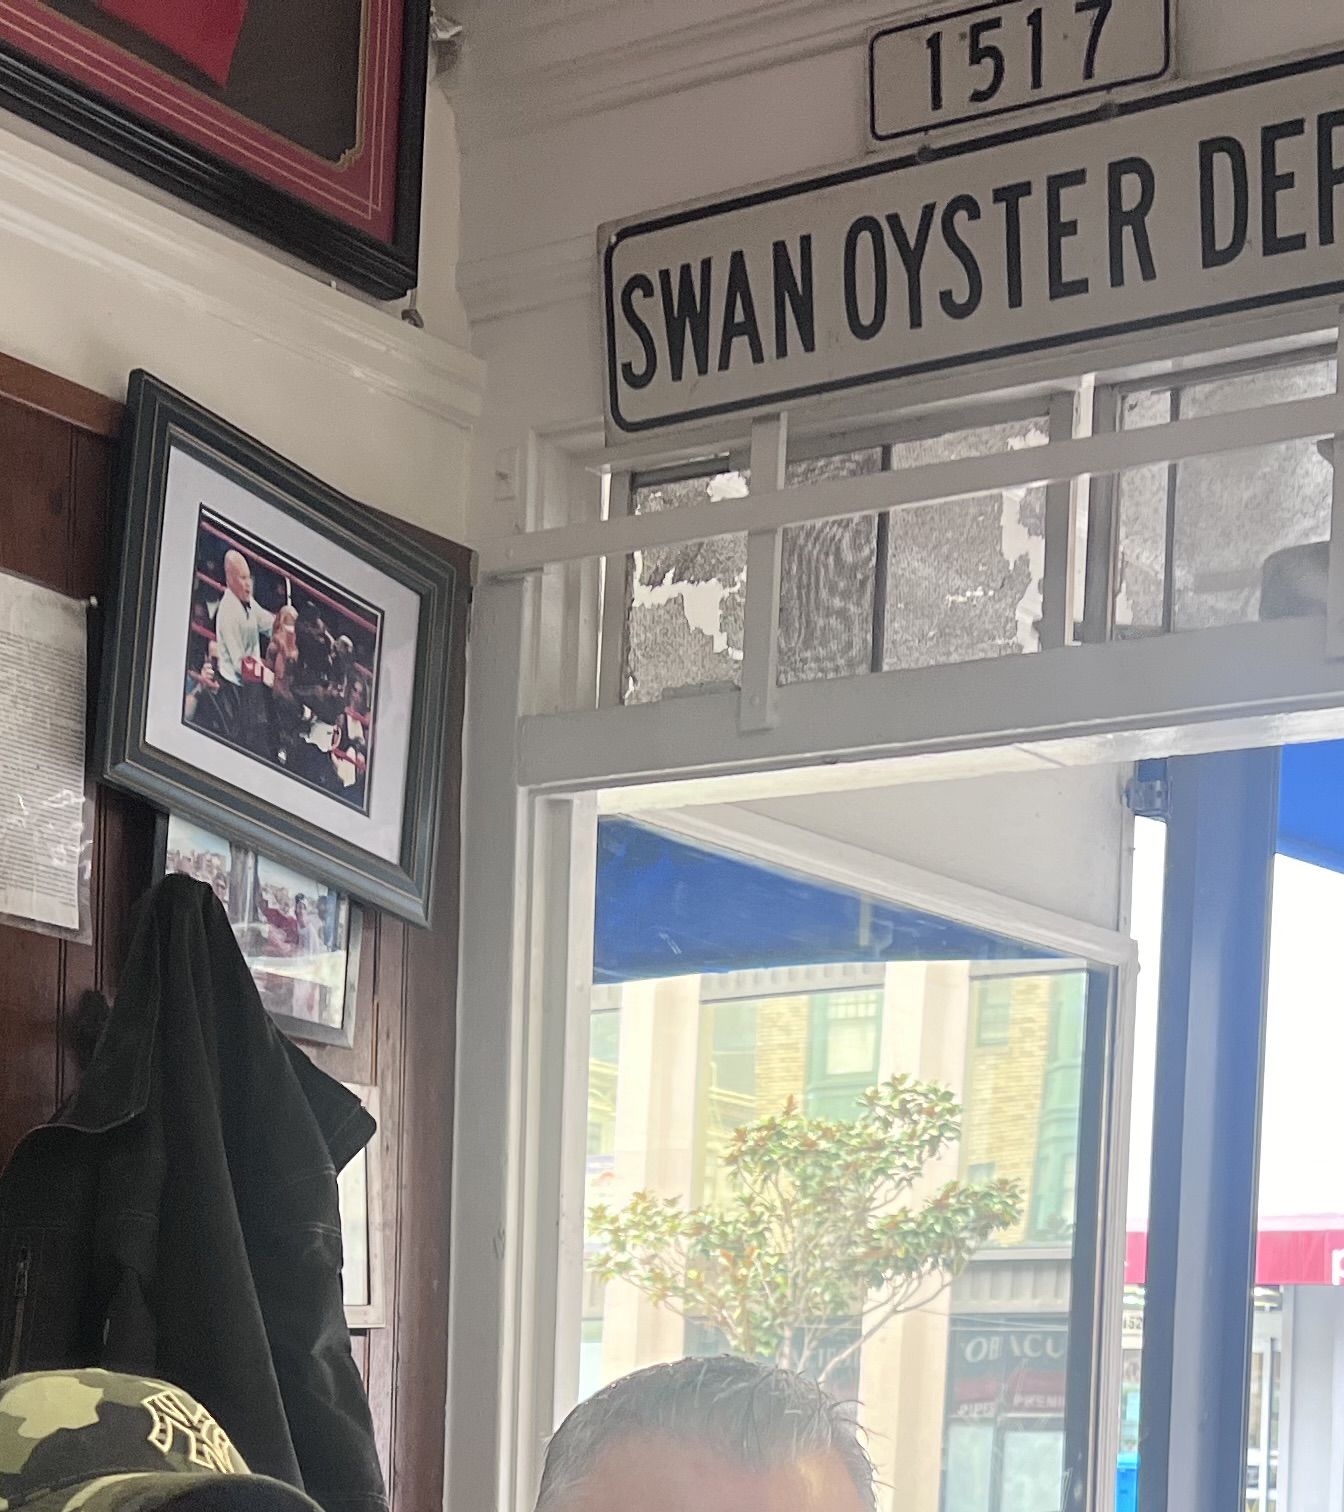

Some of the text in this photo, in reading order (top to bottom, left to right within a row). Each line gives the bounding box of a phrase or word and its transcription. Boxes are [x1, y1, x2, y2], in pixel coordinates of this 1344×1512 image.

[925, 0, 1112, 111] 1517
[621, 233, 816, 391] SWAN
[843, 156, 1157, 341] OYSTER
